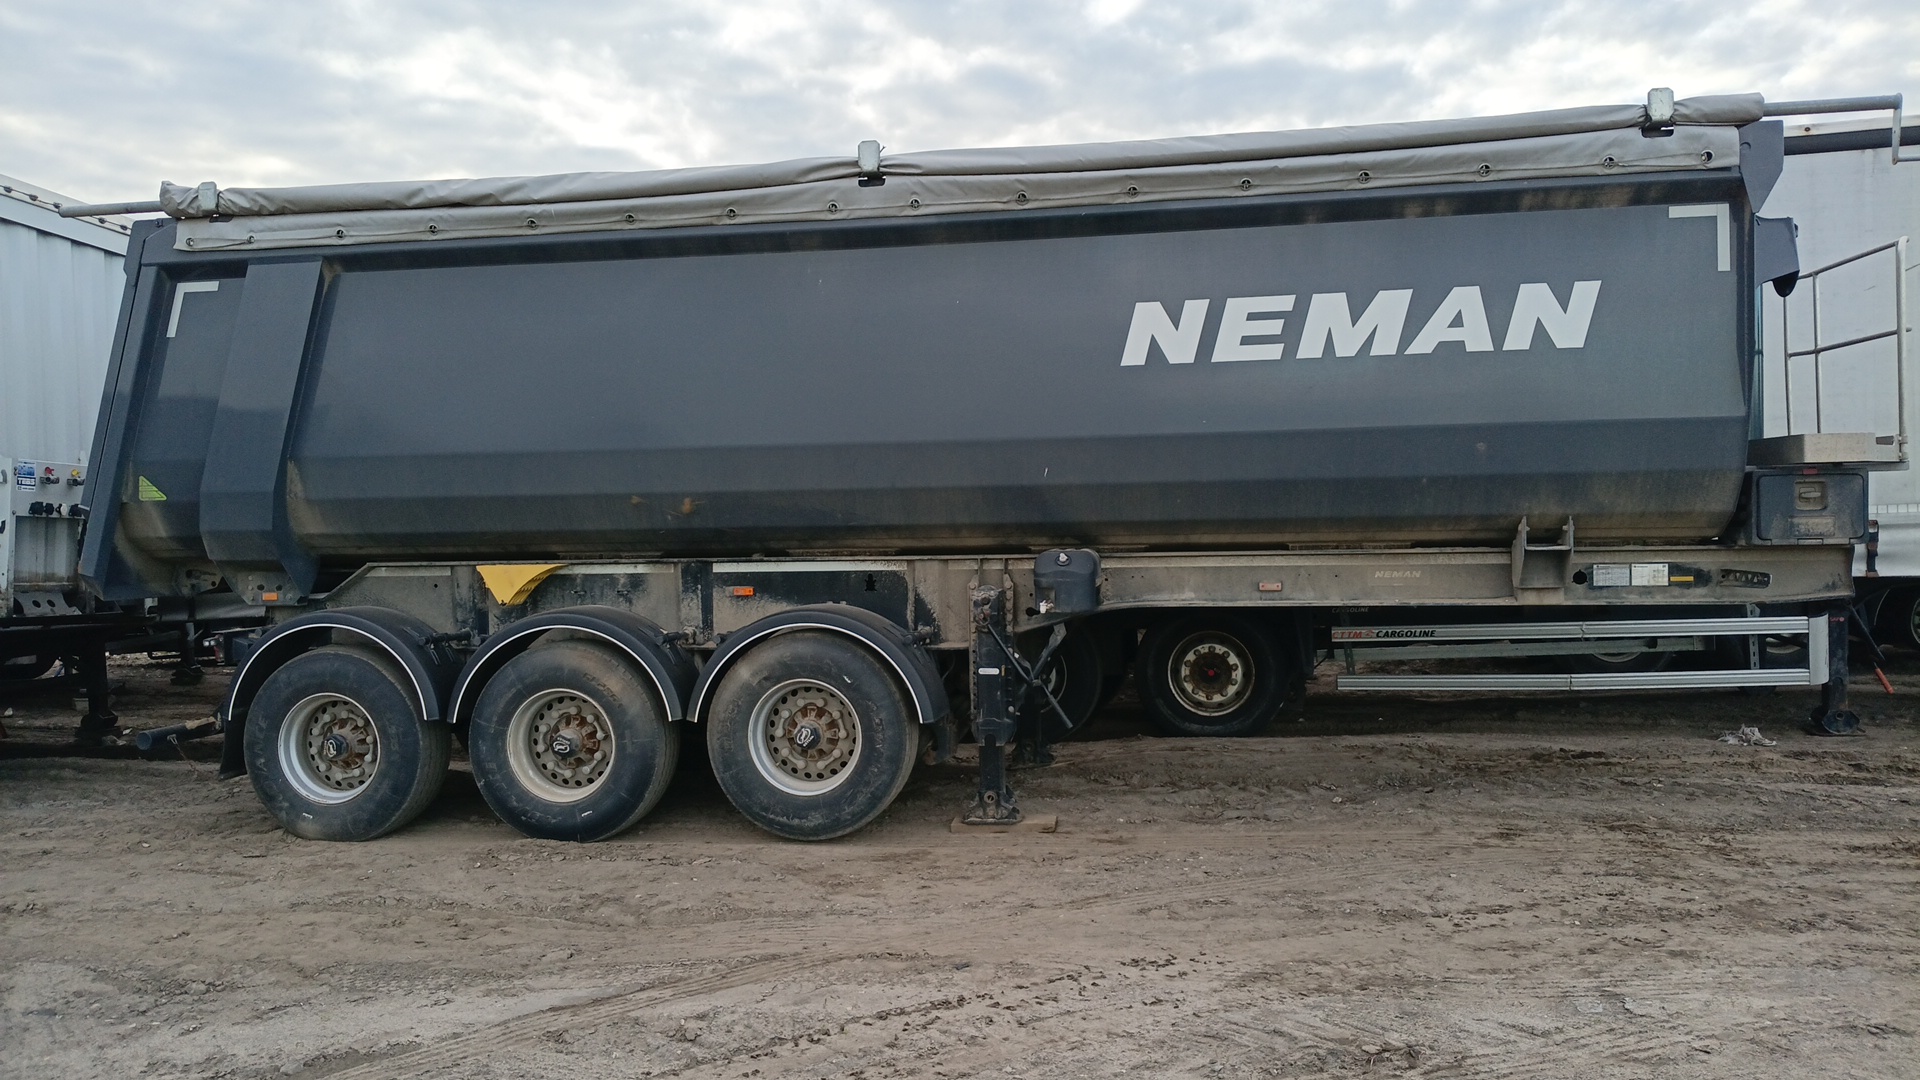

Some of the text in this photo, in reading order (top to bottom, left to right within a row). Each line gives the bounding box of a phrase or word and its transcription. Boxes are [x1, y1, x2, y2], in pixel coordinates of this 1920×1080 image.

[1121, 280, 1601, 366] NEMAN
[1374, 570, 1422, 578] NEMAN
[1376, 629, 1437, 638] CARGOLINE
